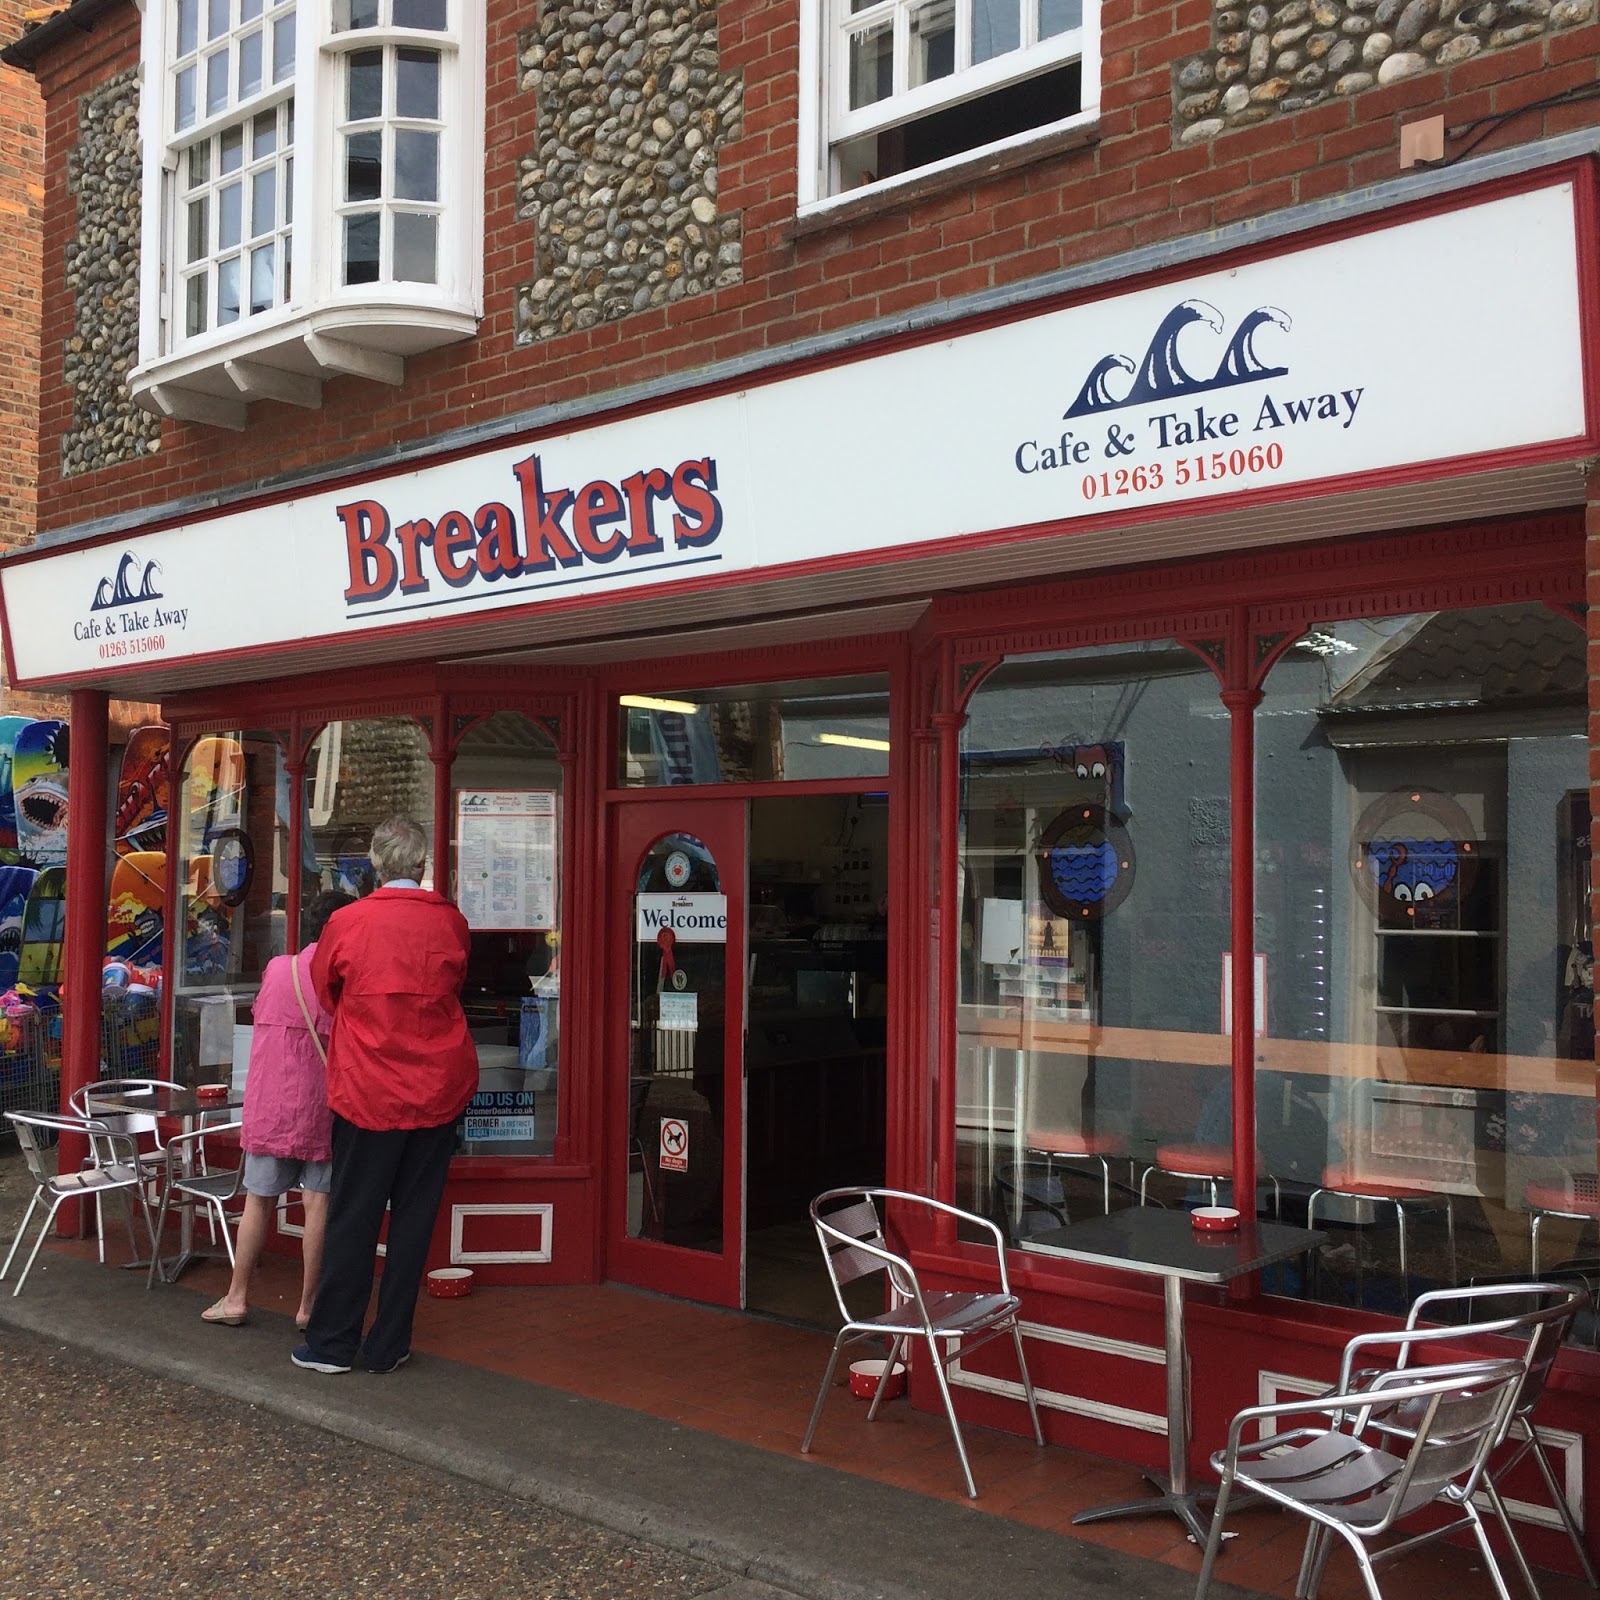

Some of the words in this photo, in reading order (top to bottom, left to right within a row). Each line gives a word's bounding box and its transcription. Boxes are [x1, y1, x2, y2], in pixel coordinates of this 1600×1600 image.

[1014, 432, 1090, 474] Cafe
[1103, 424, 1136, 458] &
[1149, 406, 1239, 449] Take
[1252, 387, 1364, 429] Away
[1081, 462, 1164, 500] 01263
[1175, 442, 1283, 486] 515060
[336, 453, 723, 606] Breakers
[74, 618, 101, 641] Cafe
[105, 616, 116, 636] &
[120, 611, 149, 633] Take
[153, 607, 188, 630] Away
[99, 640, 127, 659] 01263
[130, 634, 165, 654] 515060
[642, 908, 727, 929] Welcome
[466, 1092, 494, 1106] IND
[496, 1092, 514, 1106] US
[516, 1092, 534, 1105] ON
[466, 1107, 534, 1115] CromerDeals.co.uk
[467, 1118, 500, 1128] CROMER
[511, 1128, 528, 1136] DEALS
